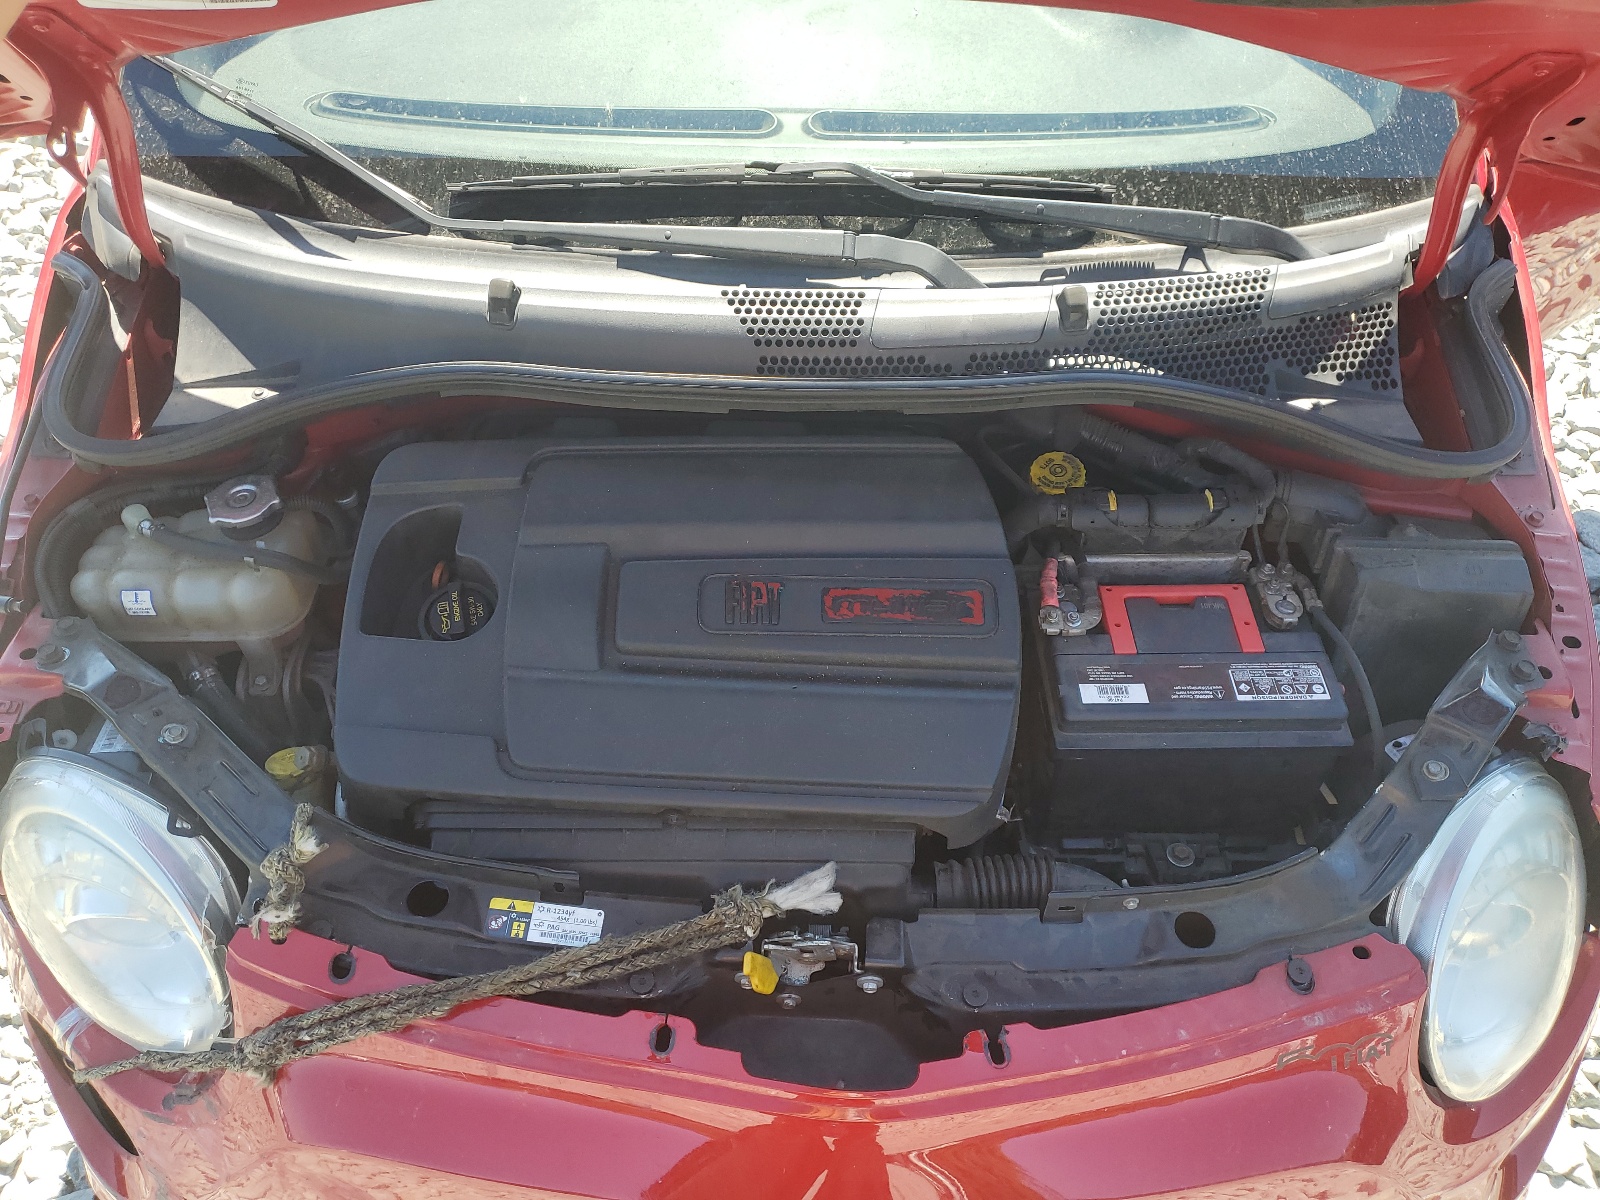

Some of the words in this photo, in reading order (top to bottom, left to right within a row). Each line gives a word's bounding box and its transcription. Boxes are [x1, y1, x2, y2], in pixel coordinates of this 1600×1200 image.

[452, 600, 461, 622] ENGINE
[468, 596, 476, 614] 5W-30
[476, 602, 484, 616] ONLY
[725, 579, 781, 626] FIAT
[546, 908, 576, 916] R-1234yf
[1344, 1040, 1394, 1069] FIAT
